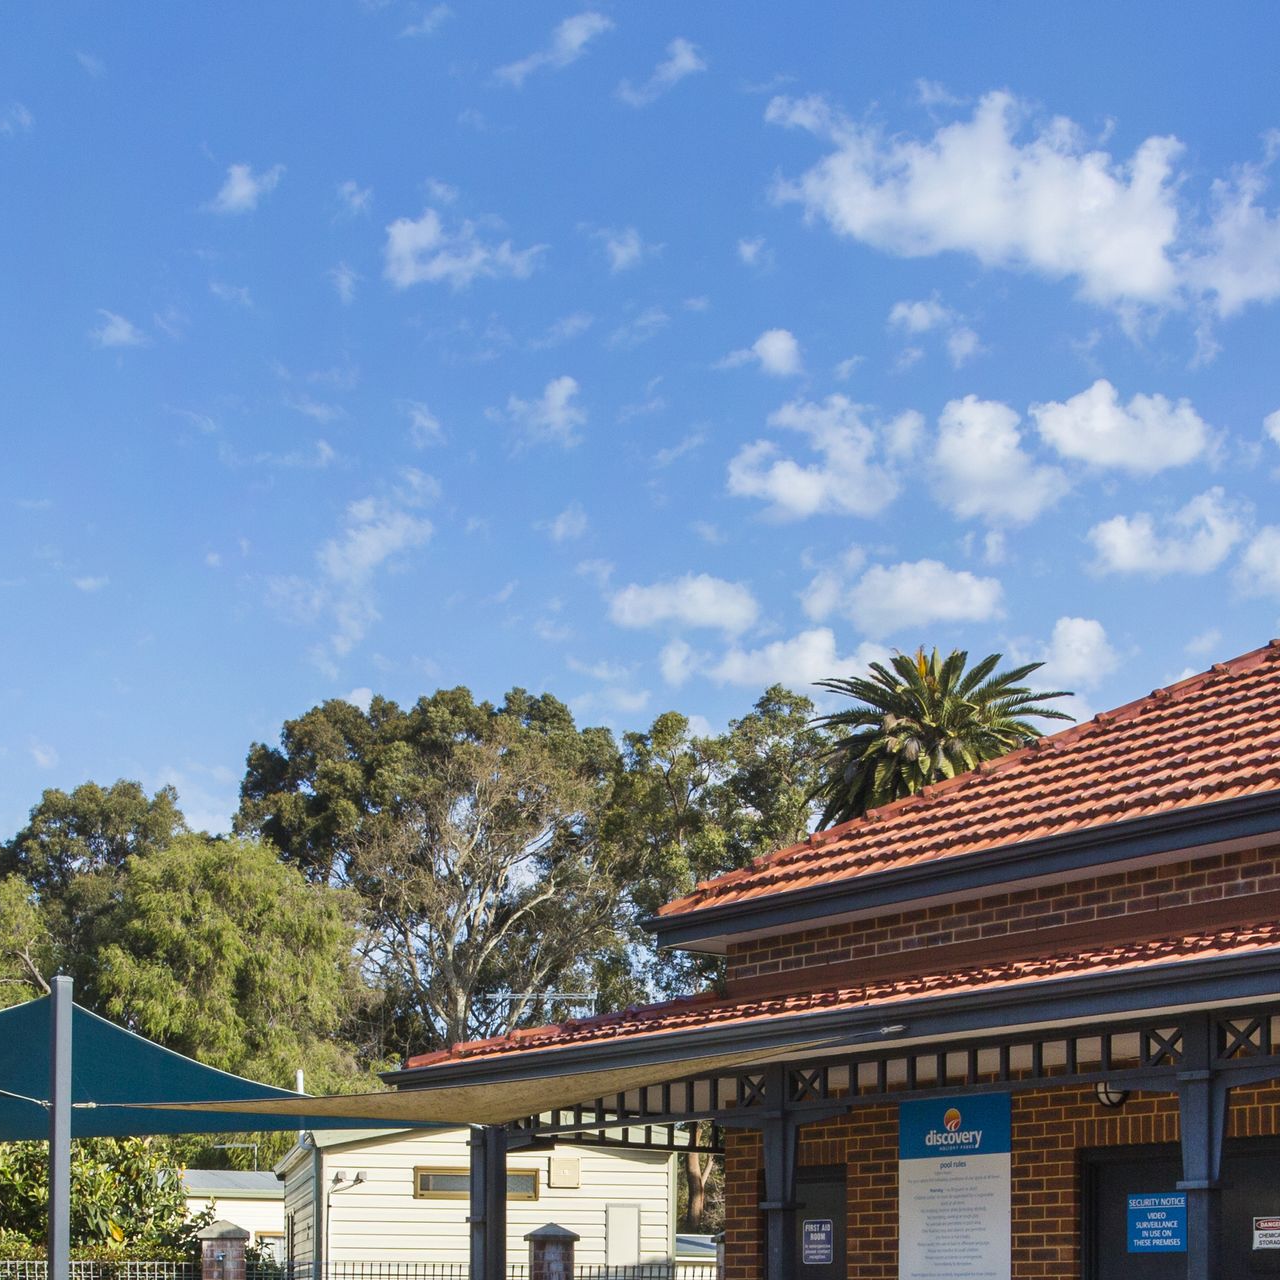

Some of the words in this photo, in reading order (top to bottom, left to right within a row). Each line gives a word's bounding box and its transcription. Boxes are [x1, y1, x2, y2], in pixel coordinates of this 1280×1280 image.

[925, 1130, 983, 1149] discovery
[940, 1161, 952, 1170] pool
[953, 1160, 966, 1168] rules
[1128, 1198, 1160, 1207] SECURITY
[1160, 1197, 1185, 1206] NOTICE
[1147, 1212, 1167, 1220] VIDEO
[805, 1224, 820, 1232] FIRST
[821, 1223, 831, 1231] AID
[1136, 1221, 1179, 1229] SURVEILLANCE
[810, 1232, 826, 1240] ROOM
[1141, 1230, 1149, 1238] IN
[1150, 1230, 1160, 1238] USE
[1161, 1229, 1172, 1237] ON
[1152, 1238, 1181, 1246] PREMISES
